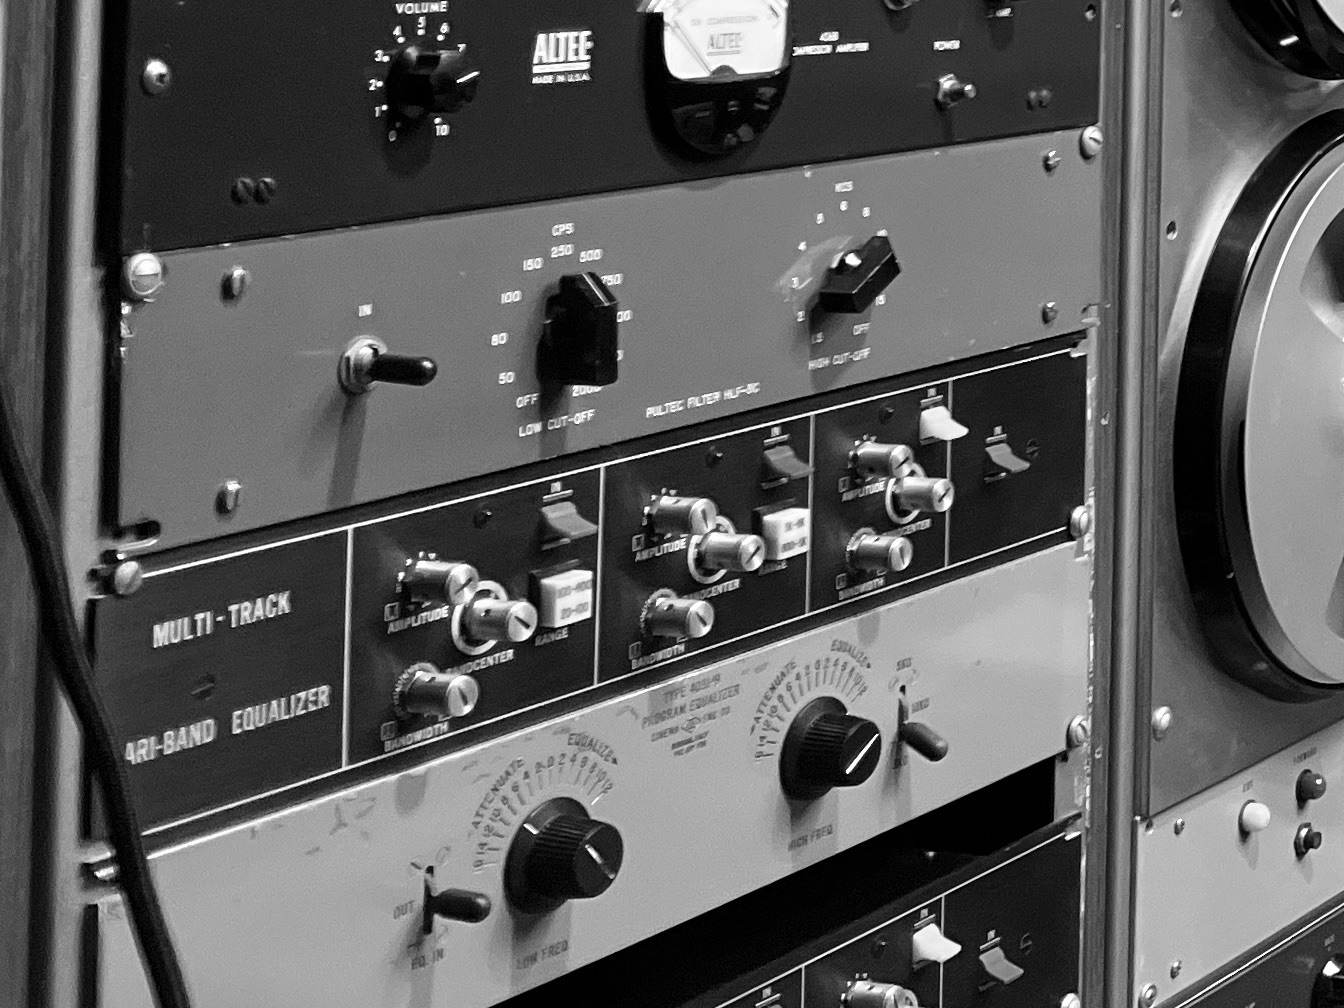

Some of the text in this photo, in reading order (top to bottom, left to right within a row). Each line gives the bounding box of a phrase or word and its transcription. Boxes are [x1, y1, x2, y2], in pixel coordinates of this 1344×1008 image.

[395, 1, 448, 14] VOLUME
[435, 124, 450, 137] 10
[552, 223, 575, 236] CPS
[551, 243, 574, 258] 250
[579, 248, 603, 262] 500
[523, 257, 544, 271] 150
[501, 290, 522, 304] 100
[499, 371, 515, 384] 50
[516, 393, 539, 408] OFF
[646, 399, 685, 418] PULTEC
[687, 391, 721, 407] FILTER
[519, 409, 596, 437] LOW CUT-OFF
[387, 605, 450, 635] AMPLITUDE
[535, 627, 569, 647] RANGE
[124, 684, 331, 766] ARI-BAND EQUALIZER
[384, 721, 449, 753] BANDWIDTH
[567, 732, 613, 763] EQUALIZE
[472, 758, 524, 829] ATTENUATE
[393, 900, 416, 920] OUT
